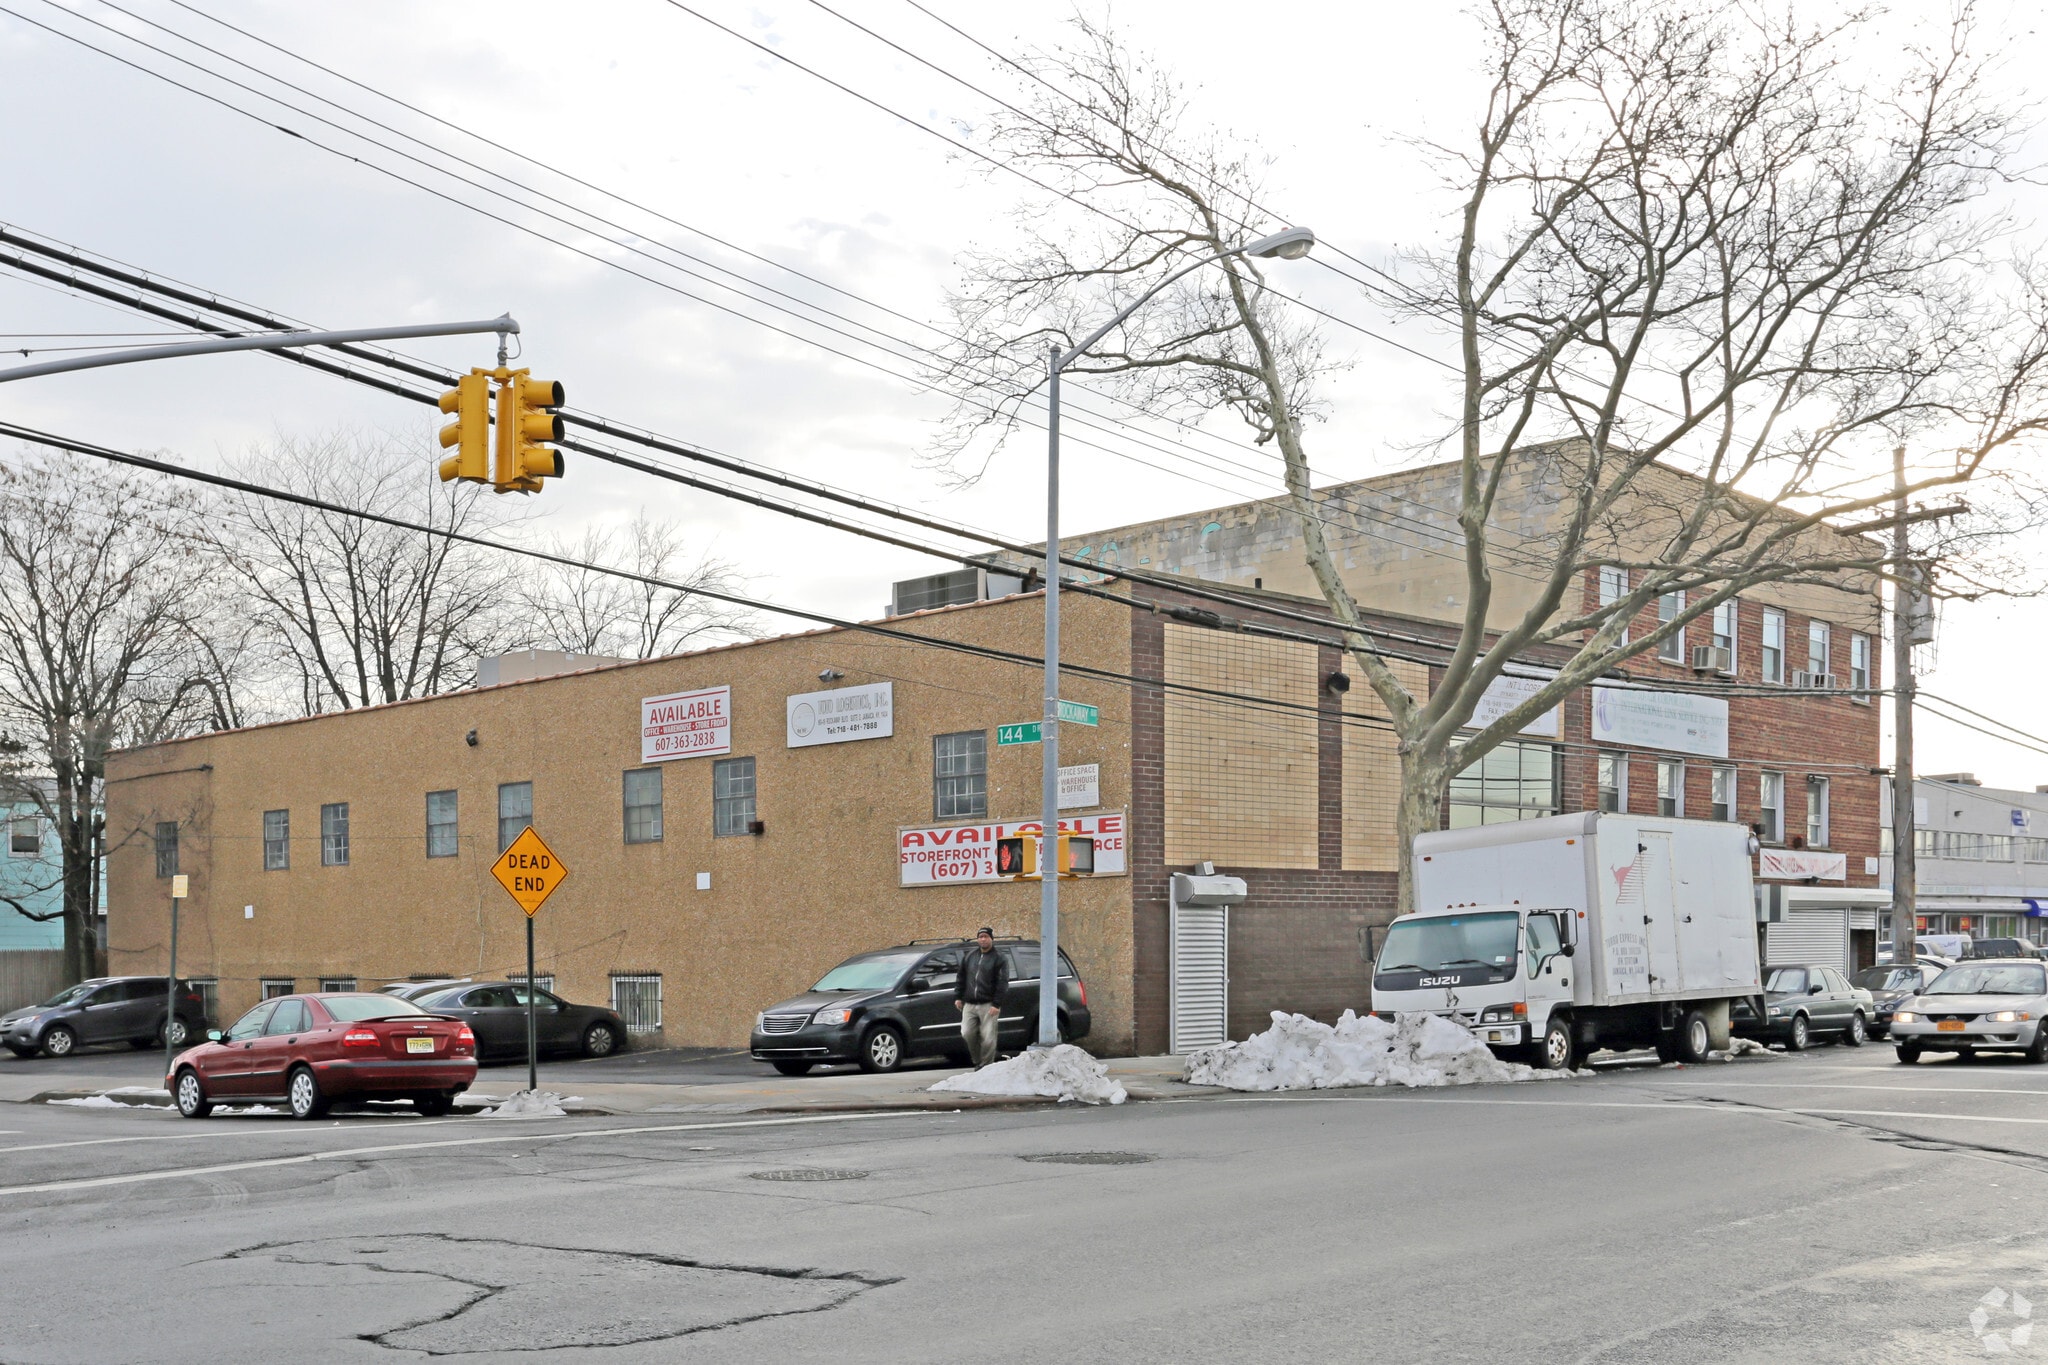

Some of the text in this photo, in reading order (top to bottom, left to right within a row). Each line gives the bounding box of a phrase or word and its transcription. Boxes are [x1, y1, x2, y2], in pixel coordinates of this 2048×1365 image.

[650, 699, 721, 724] AVAILABLE
[644, 717, 727, 737] OFFICE WAREHOUSE STORE FRONT
[999, 726, 1023, 743] 144
[655, 731, 715, 751] 607-363-2838
[1057, 766, 1096, 777] OFFICE SPACE
[1060, 775, 1097, 786] WAREHOUSE
[1066, 784, 1087, 794] OFFICE
[508, 853, 551, 870] DEAD
[901, 847, 989, 864] STOREFRONT
[931, 860, 978, 880] (607)
[514, 876, 545, 892] END
[1419, 975, 1461, 987] ISUZU
